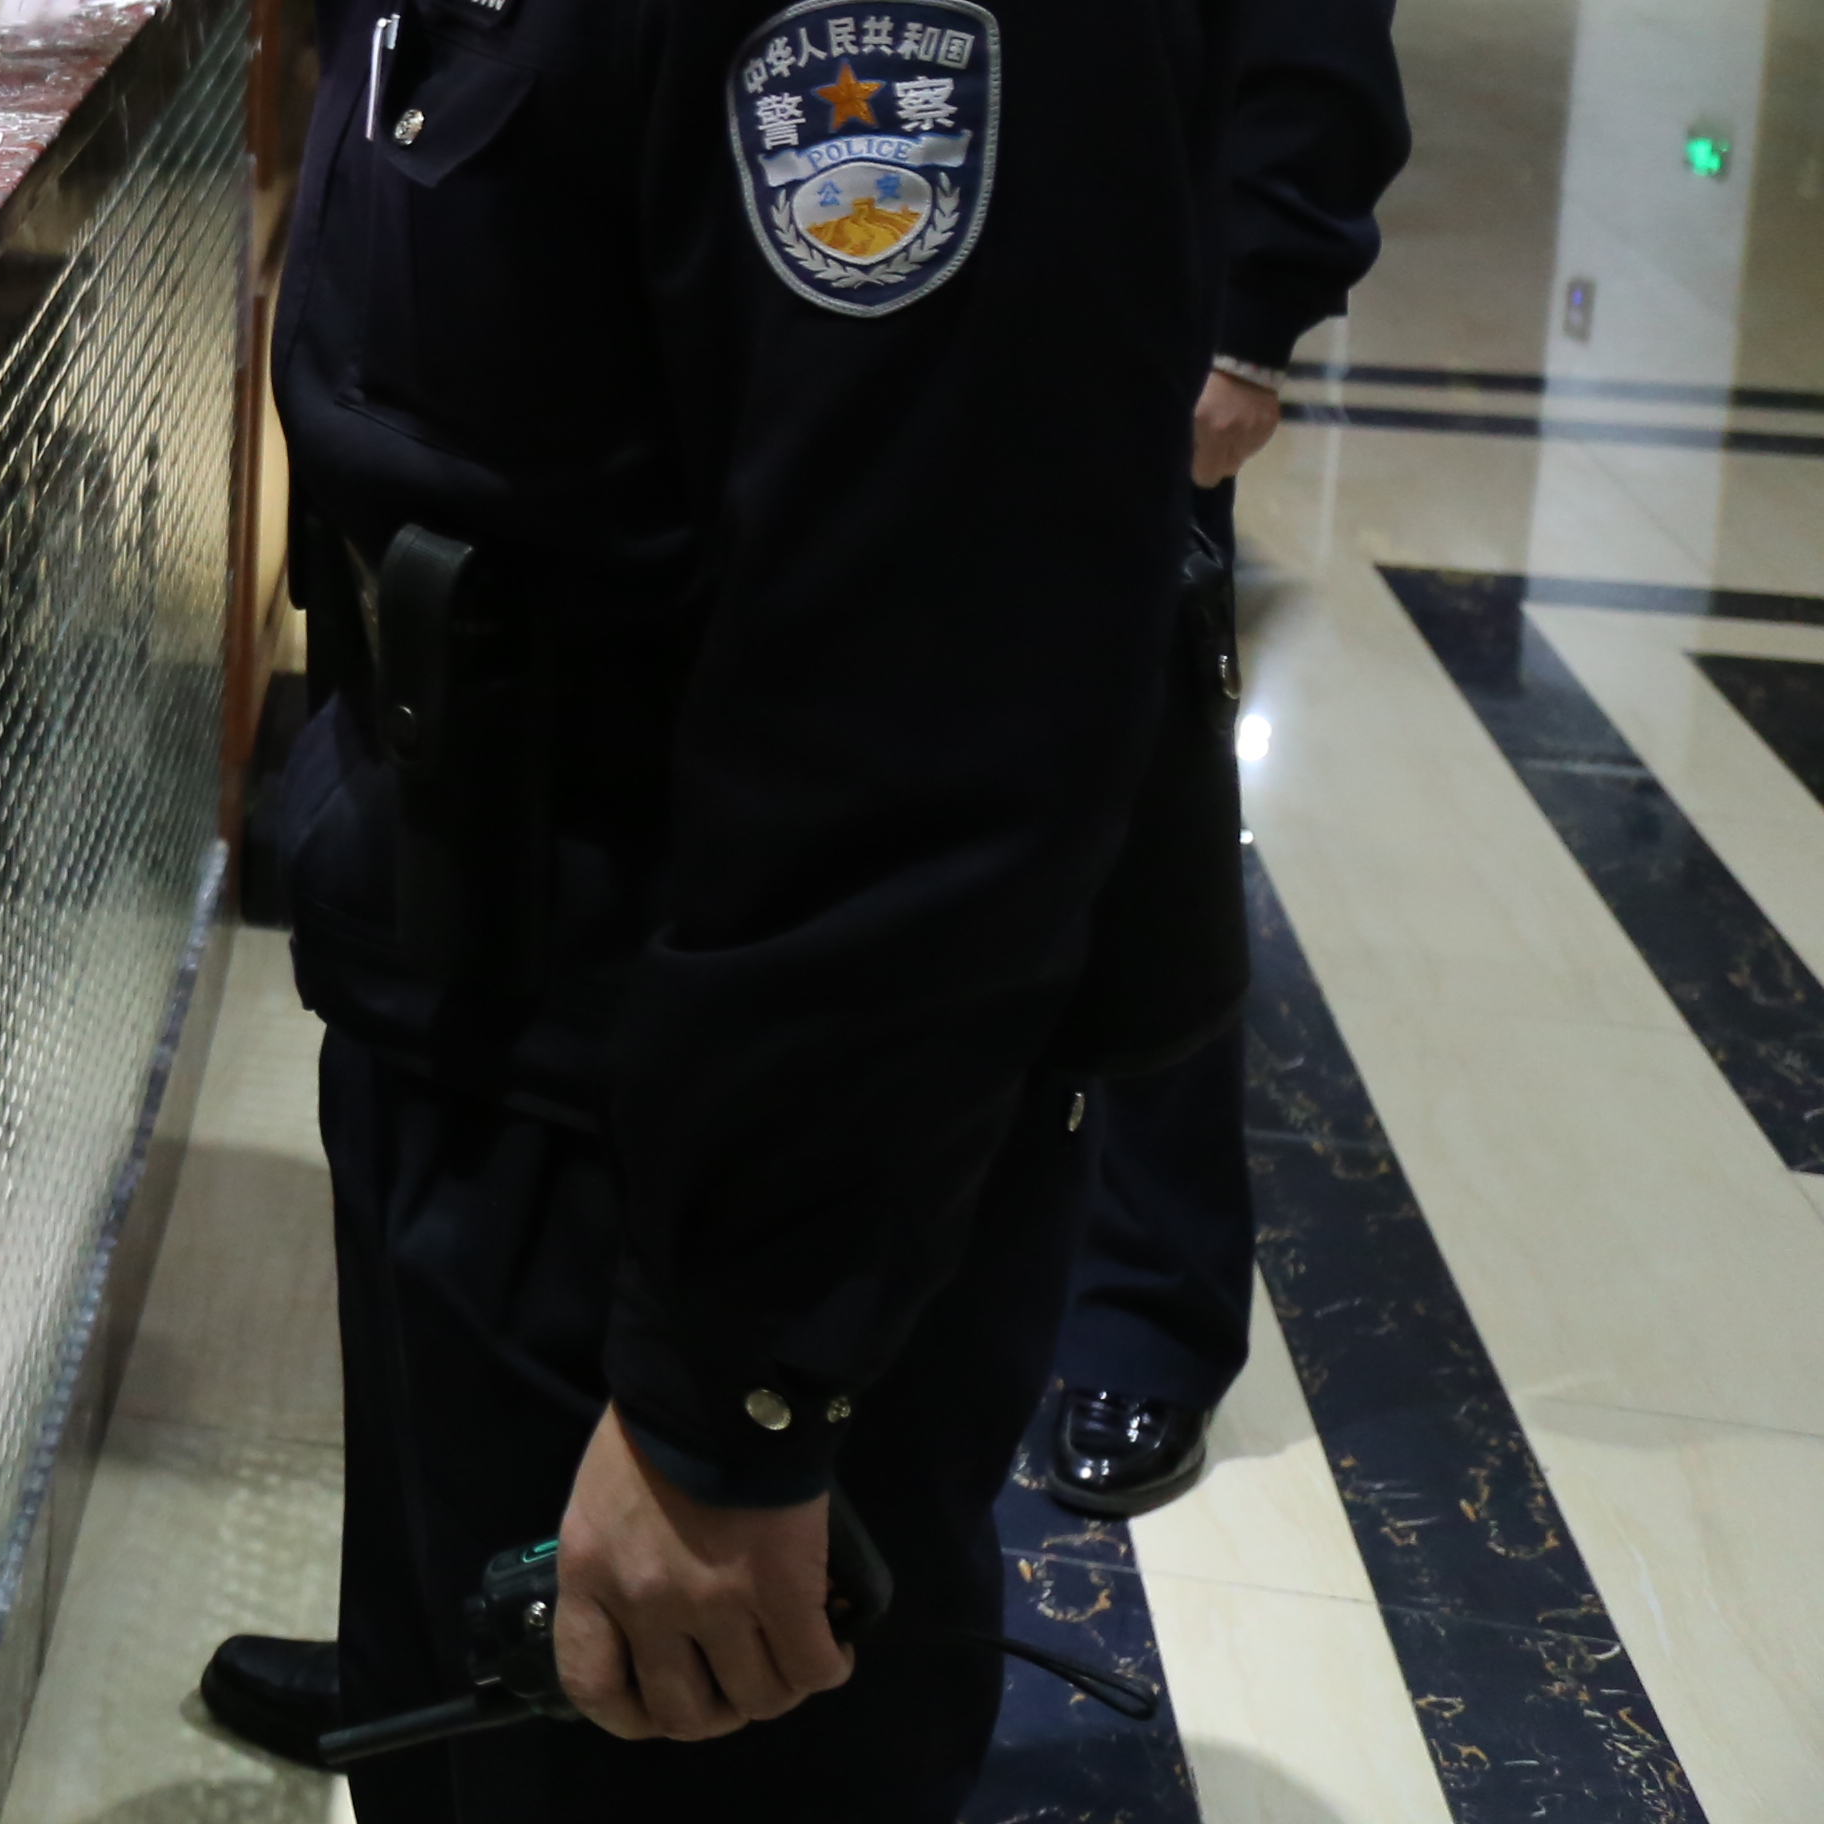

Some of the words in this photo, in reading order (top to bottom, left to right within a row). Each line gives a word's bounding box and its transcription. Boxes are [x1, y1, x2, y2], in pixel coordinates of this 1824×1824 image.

[742, 15, 975, 94] 中华人民共和国
[756, 91, 806, 151] 警
[894, 76, 958, 133] 察
[807, 137, 913, 170] POLICE
